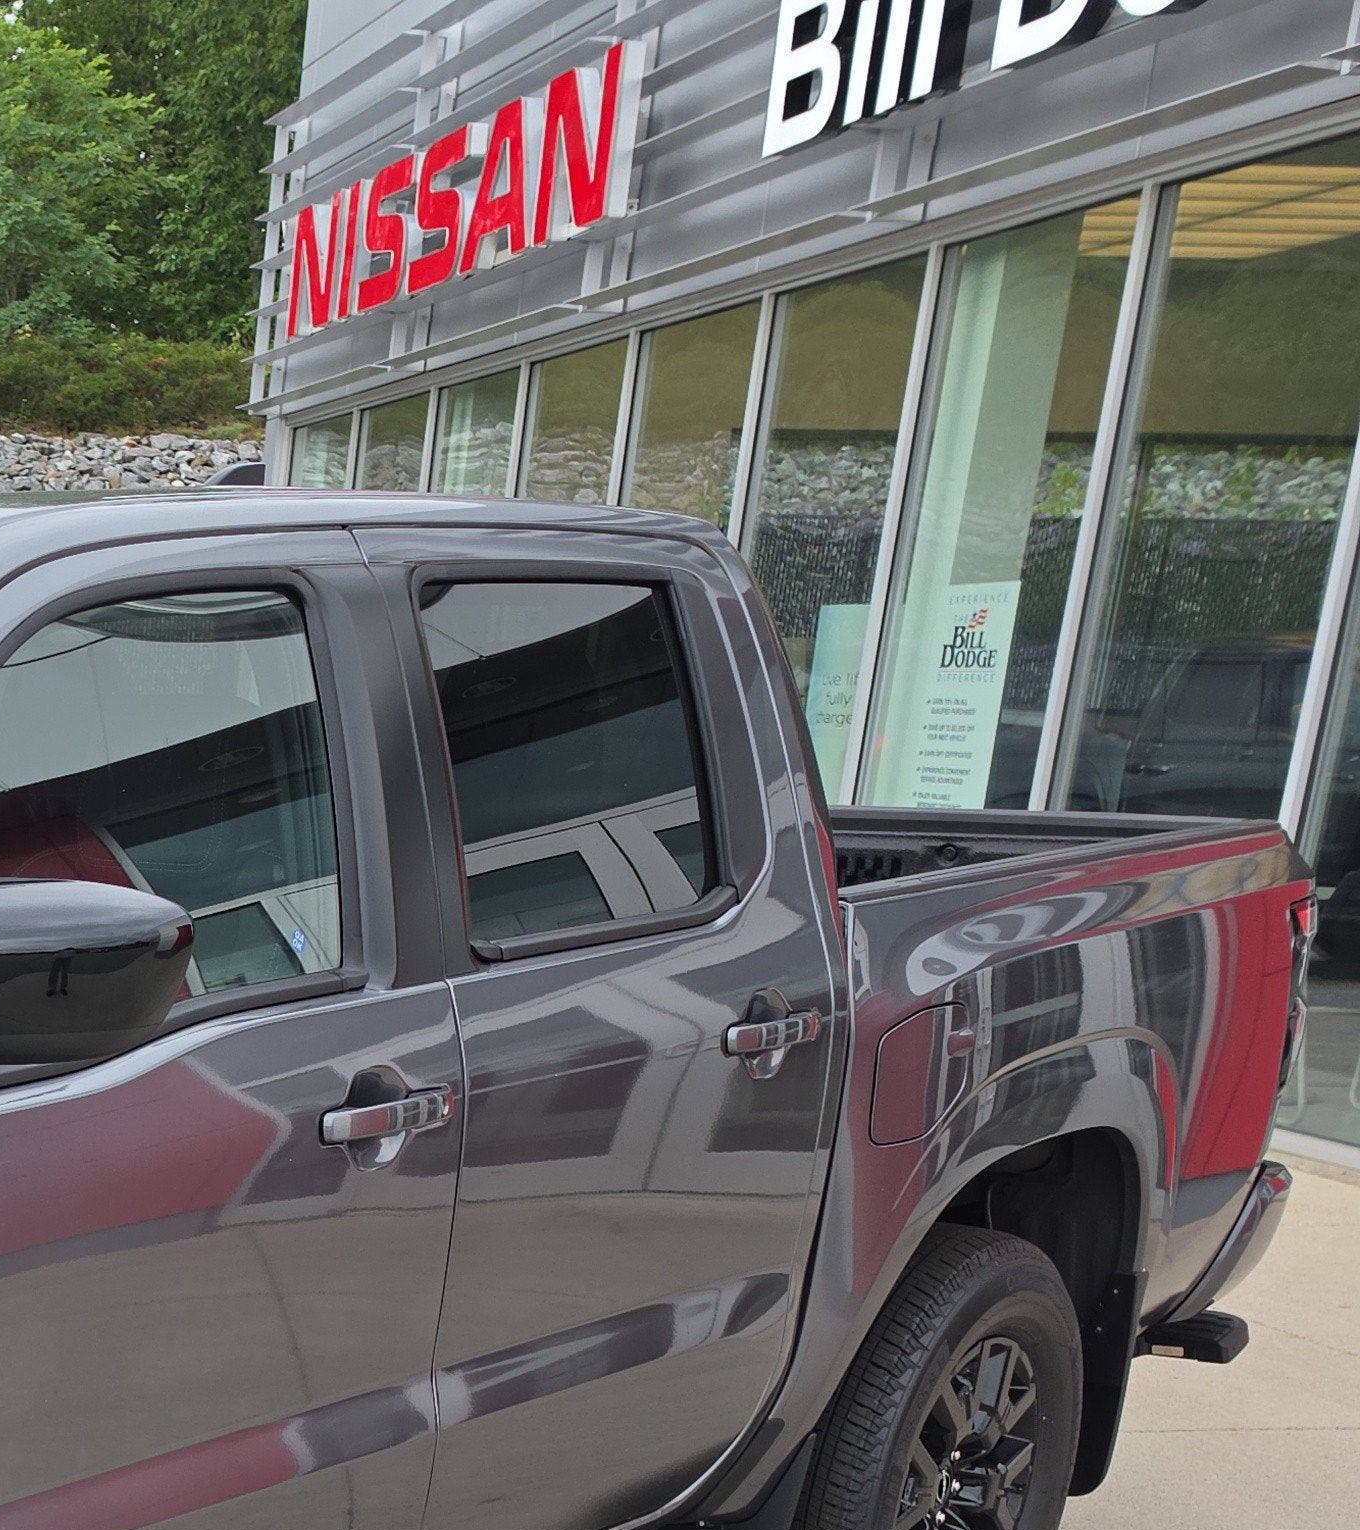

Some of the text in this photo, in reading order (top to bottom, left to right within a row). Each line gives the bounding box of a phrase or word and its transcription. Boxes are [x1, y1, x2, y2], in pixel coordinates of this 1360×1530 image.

[762, 0, 945, 158] Bill
[285, 40, 625, 340] NISSAN
[948, 593, 1009, 605] EXPERIENCE
[937, 673, 996, 682] DIFFERENCE
